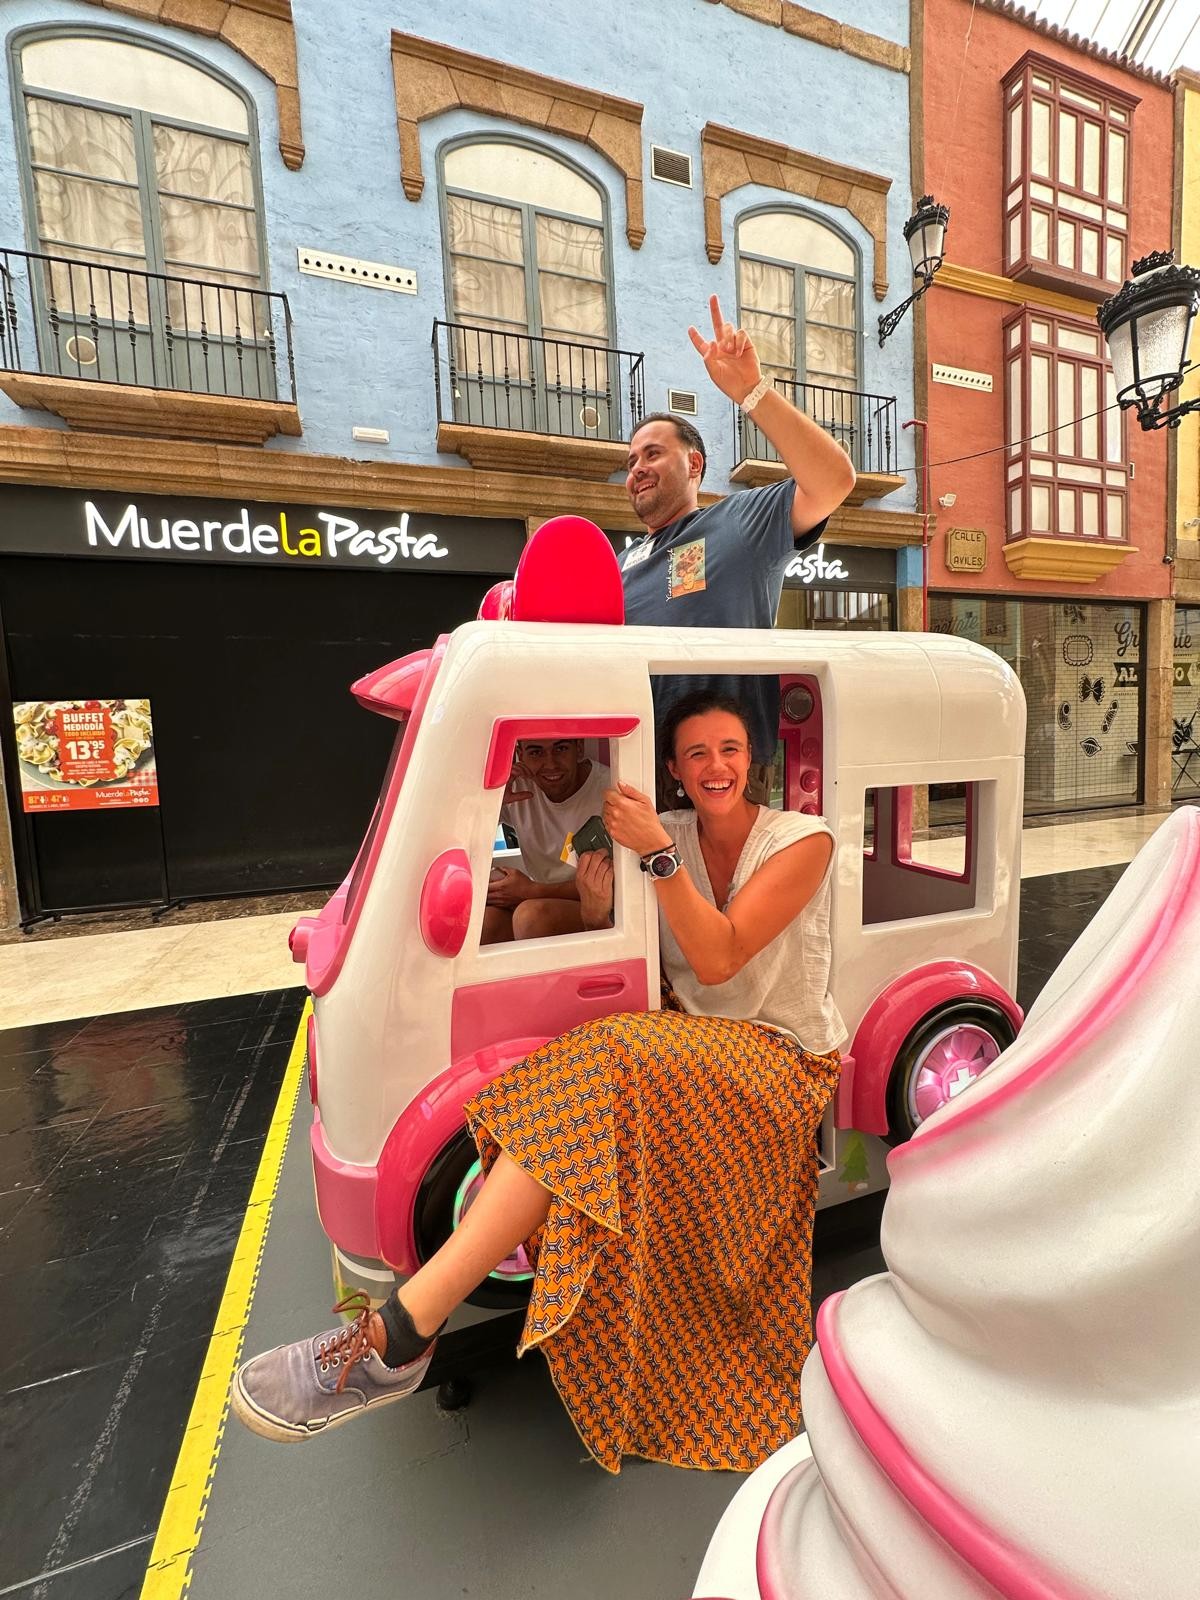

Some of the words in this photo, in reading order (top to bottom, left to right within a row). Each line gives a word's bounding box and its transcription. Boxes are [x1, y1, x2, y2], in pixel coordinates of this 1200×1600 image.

[954, 531, 982, 542] CALLE
[785, 542, 849, 584] asta
[953, 555, 983, 567] AVILES
[62, 713, 104, 723] BUFFET
[63, 722, 104, 731] MEDIODÍA
